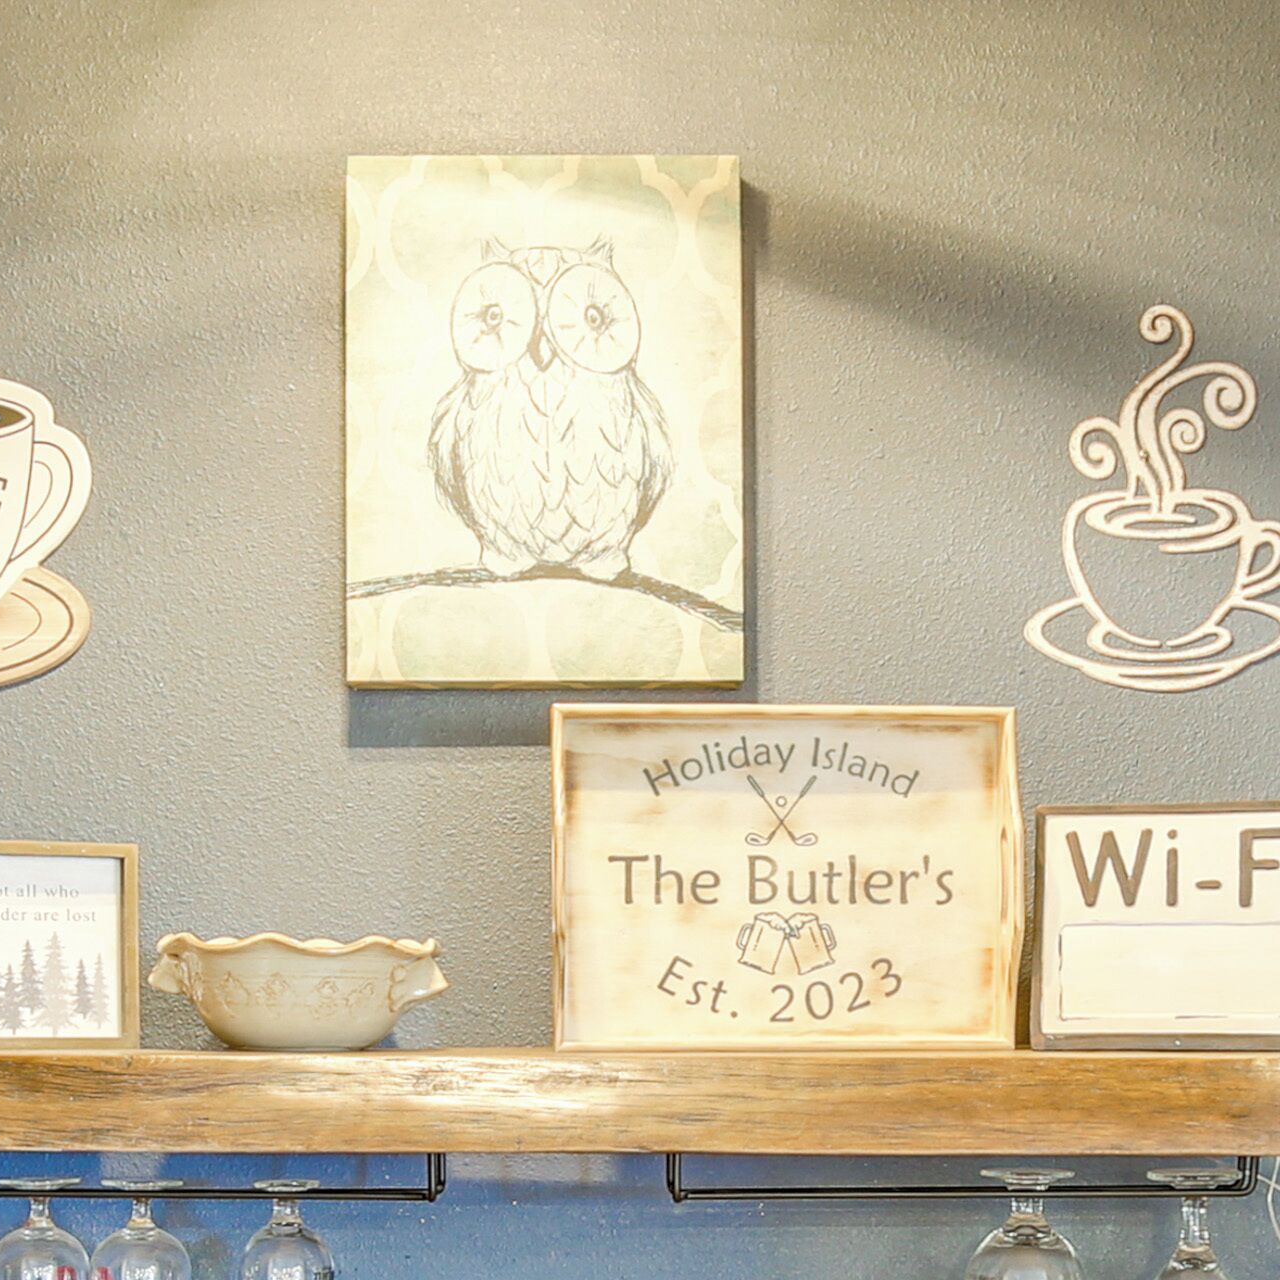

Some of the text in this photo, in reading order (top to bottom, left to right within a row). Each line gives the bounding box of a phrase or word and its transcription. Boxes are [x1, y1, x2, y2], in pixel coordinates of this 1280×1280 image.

[642, 736, 920, 798] Holiday Island
[16, 884, 36, 898] all
[44, 885, 79, 898] who
[608, 854, 954, 906] The Butler's
[34, 911, 58, 922] are
[67, 909, 97, 922] lost
[657, 955, 902, 1022] Est. 2023
